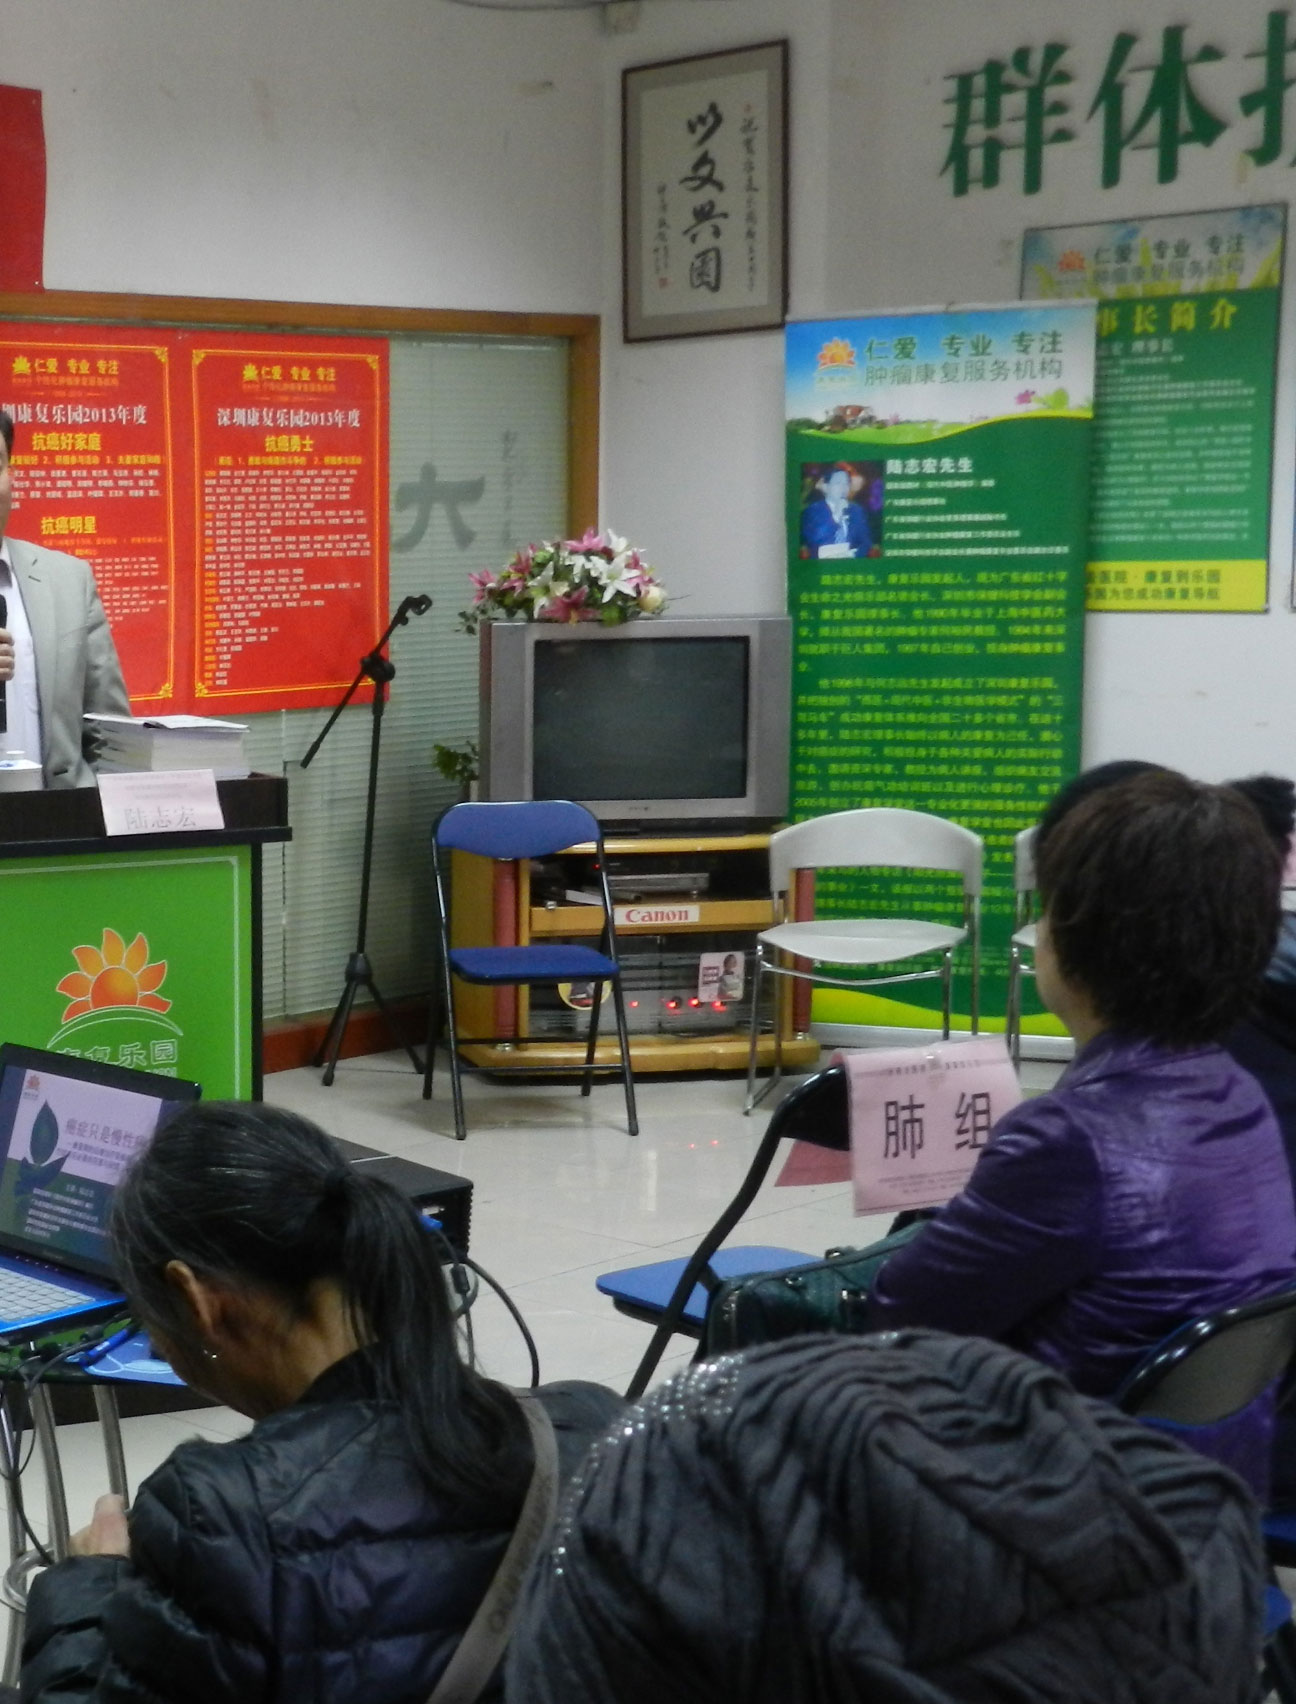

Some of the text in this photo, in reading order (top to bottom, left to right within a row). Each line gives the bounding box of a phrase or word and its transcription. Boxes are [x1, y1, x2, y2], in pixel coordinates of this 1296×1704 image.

[865, 330, 1064, 361] 仁爱 专业 专注
[864, 359, 1064, 387] 肿瘤康复服务机构
[216, 406, 361, 429] 深圳康复乐园2013年度
[31, 431, 102, 452] 抗癌好家庭
[40, 515, 98, 536] 抗癌明星
[624, 908, 690, 924] Canon
